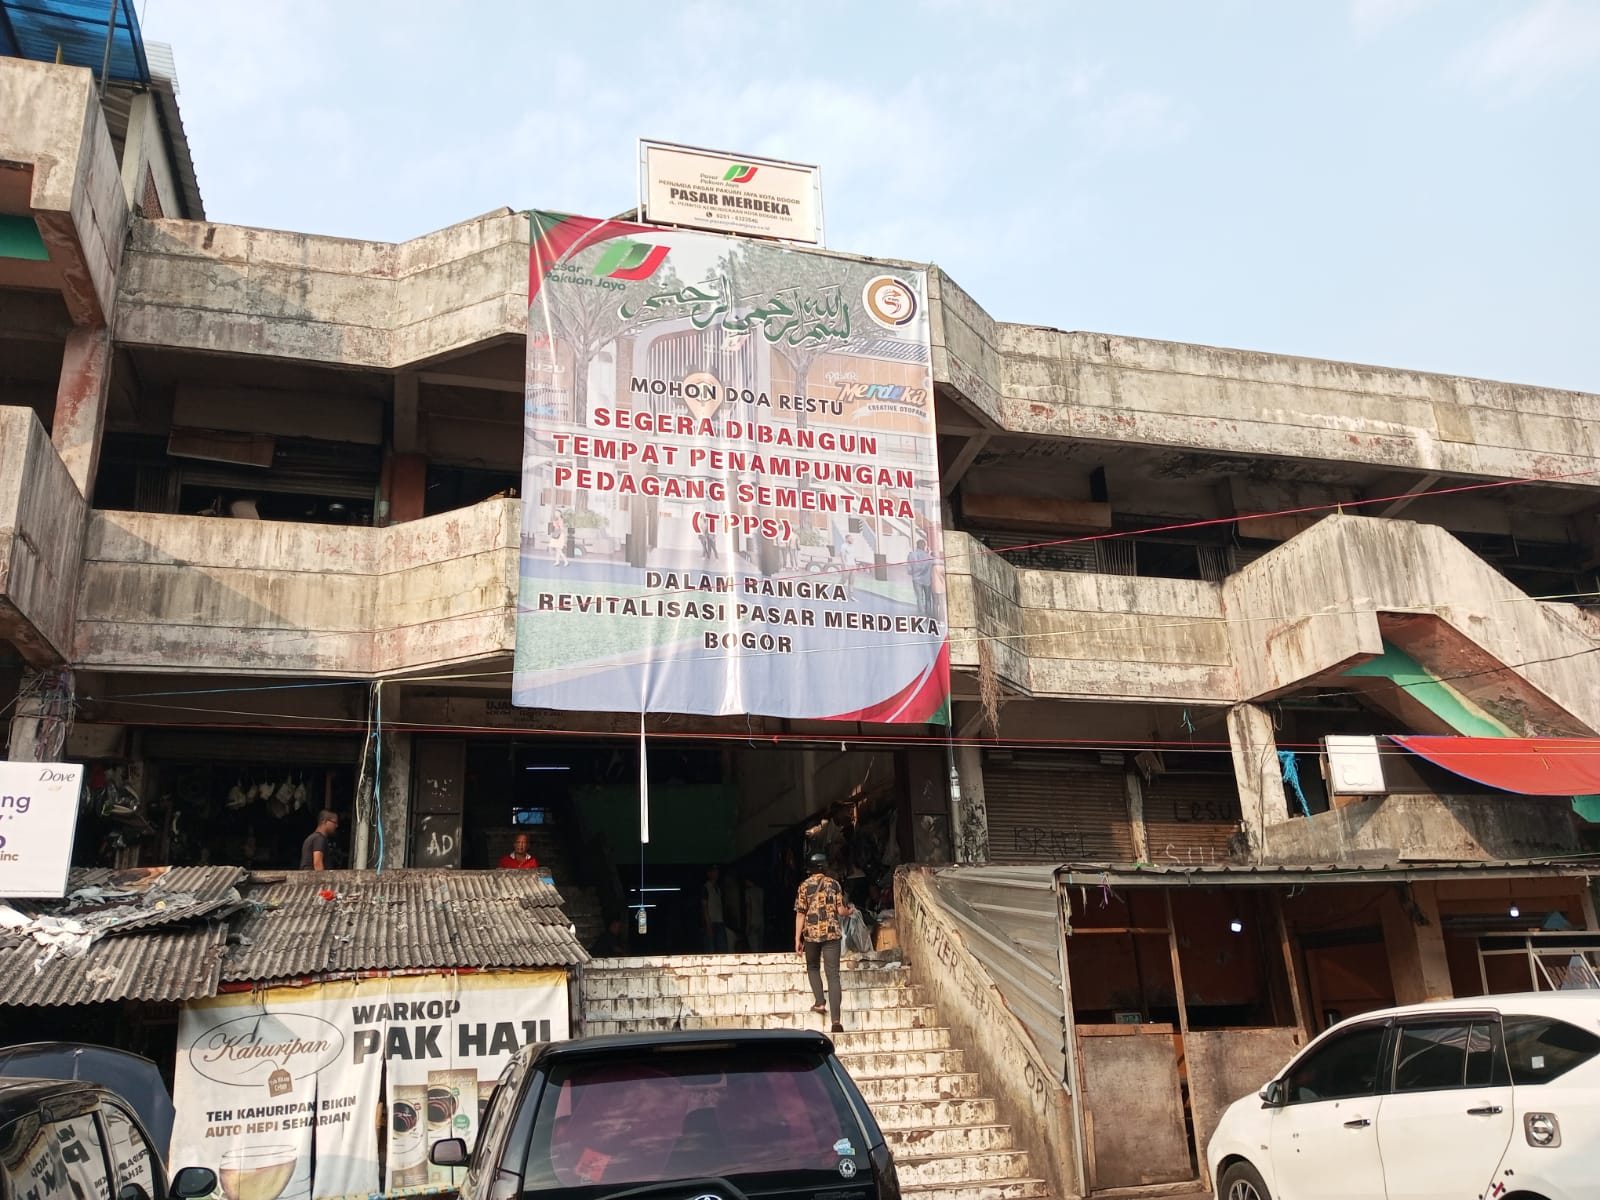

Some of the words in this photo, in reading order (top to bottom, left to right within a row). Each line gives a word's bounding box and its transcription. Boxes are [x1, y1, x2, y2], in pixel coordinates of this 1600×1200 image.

[670, 187, 718, 205] PASAR
[722, 194, 791, 216] MERDEKA
[693, 184, 715, 192] PASAR
[715, 187, 742, 196] PAKUAN
[743, 190, 758, 198] JAYA
[545, 271, 593, 287] Pakuan
[595, 277, 627, 292] Jaya
[630, 376, 717, 401] MOHON
[725, 386, 772, 408] DOA
[779, 394, 843, 416] RESTU
[594, 407, 715, 438] SEGERA
[726, 420, 877, 455] DIBANGUN
[553, 434, 678, 467] TEMPAT
[690, 447, 913, 489] PENAMPUNGAN
[554, 466, 726, 502] PEDAGANG
[738, 484, 915, 519] SEMENTARA
[692, 511, 792, 542] (TPPS)
[645, 571, 735, 594] DALAM
[744, 576, 847, 602] RANGKA
[538, 593, 726, 622] REVITALISASI
[735, 604, 815, 627] PASAR
[824, 610, 941, 637] MERDEKA
[704, 631, 793, 654] BOGOR
[39, 768, 76, 782] Dove
[351, 999, 460, 1026] WARKOP
[202, 1032, 331, 1067] Kahuripan
[353, 1024, 444, 1065] PAK
[457, 1019, 552, 1057] HAJI
[205, 1123, 242, 1138] AUTO
[246, 1119, 279, 1134] HEPI
[282, 1111, 351, 1131] SEHARIAN
[206, 1110, 234, 1123] TEH
[237, 1102, 317, 1120] KAHURIPAN
[322, 1096, 357, 1112] BIKIN
